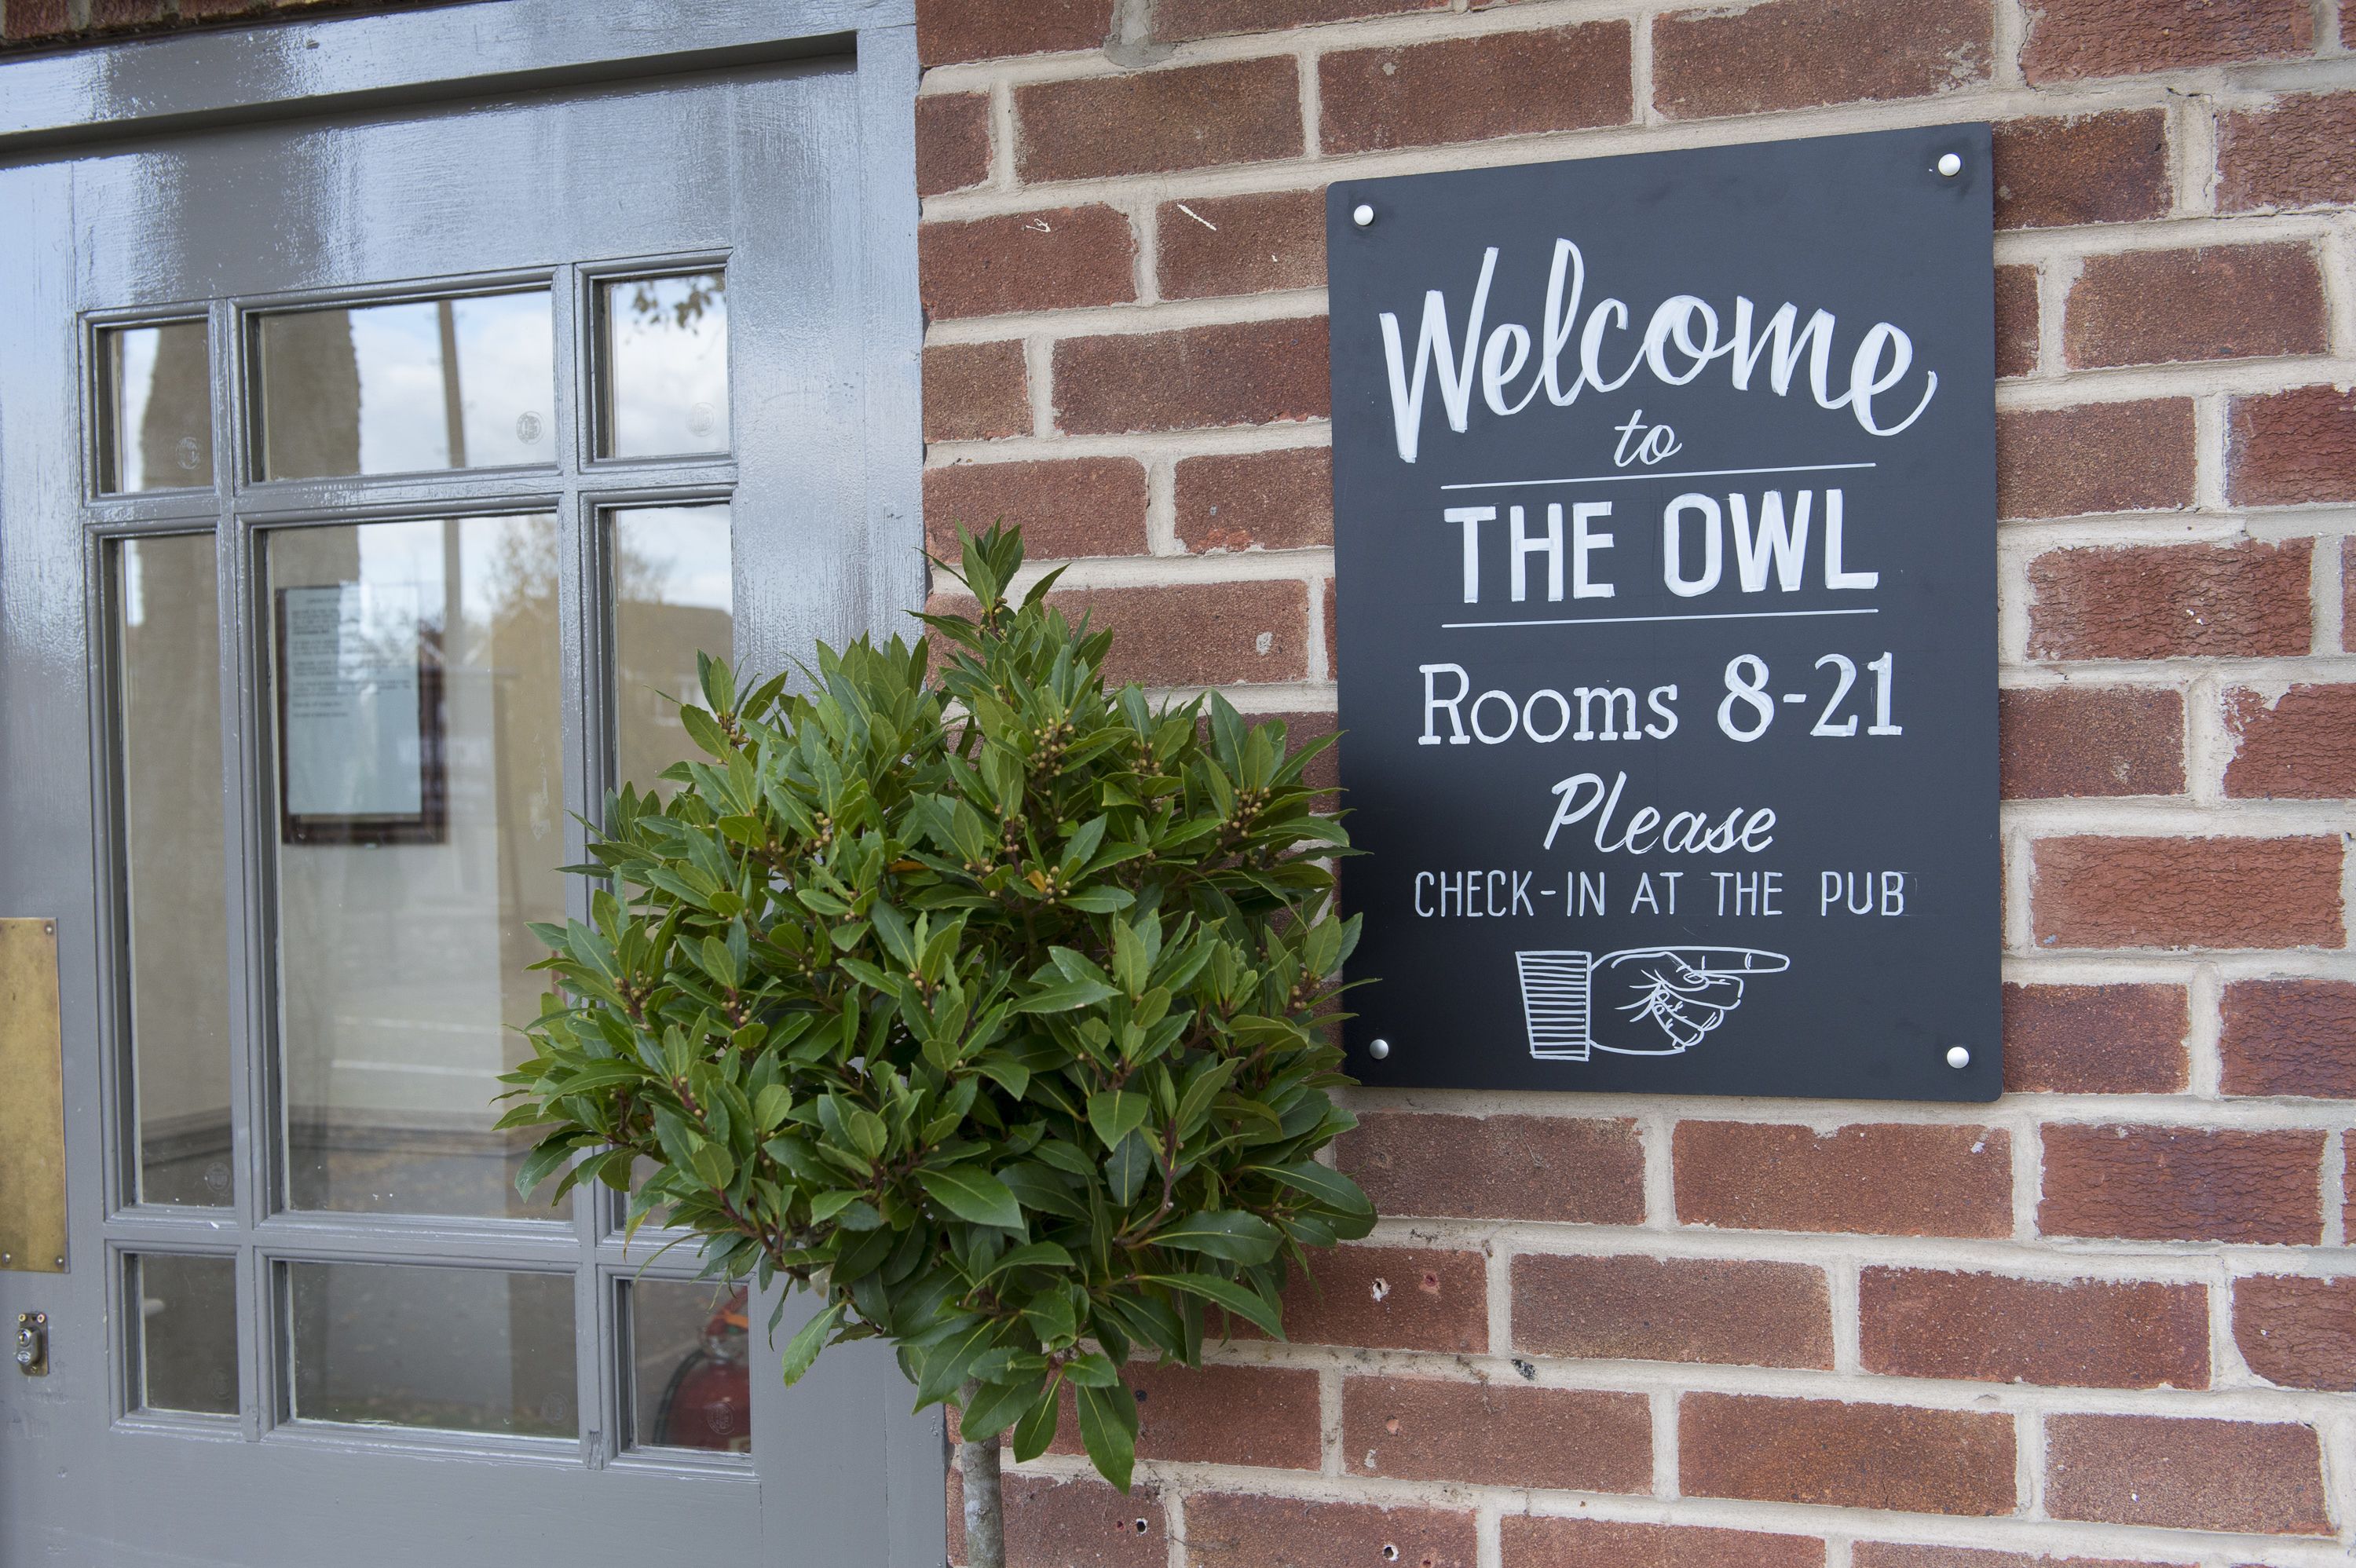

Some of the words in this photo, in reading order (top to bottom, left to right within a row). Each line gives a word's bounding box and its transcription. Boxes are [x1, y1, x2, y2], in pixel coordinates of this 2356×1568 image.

[1379, 237, 1938, 463] Welcome
[1614, 408, 1682, 468] to
[1443, 501, 1615, 604] THE
[1663, 488, 1879, 598] OWL
[1418, 663, 1678, 746] Rooms
[1717, 651, 1903, 743] 8-21
[1543, 770, 1776, 855] Please
[1415, 870, 1605, 917] CHECK-IN
[1630, 871, 1684, 916] AT
[1710, 871, 1783, 916] THE
[1820, 871, 1904, 916] PUB
